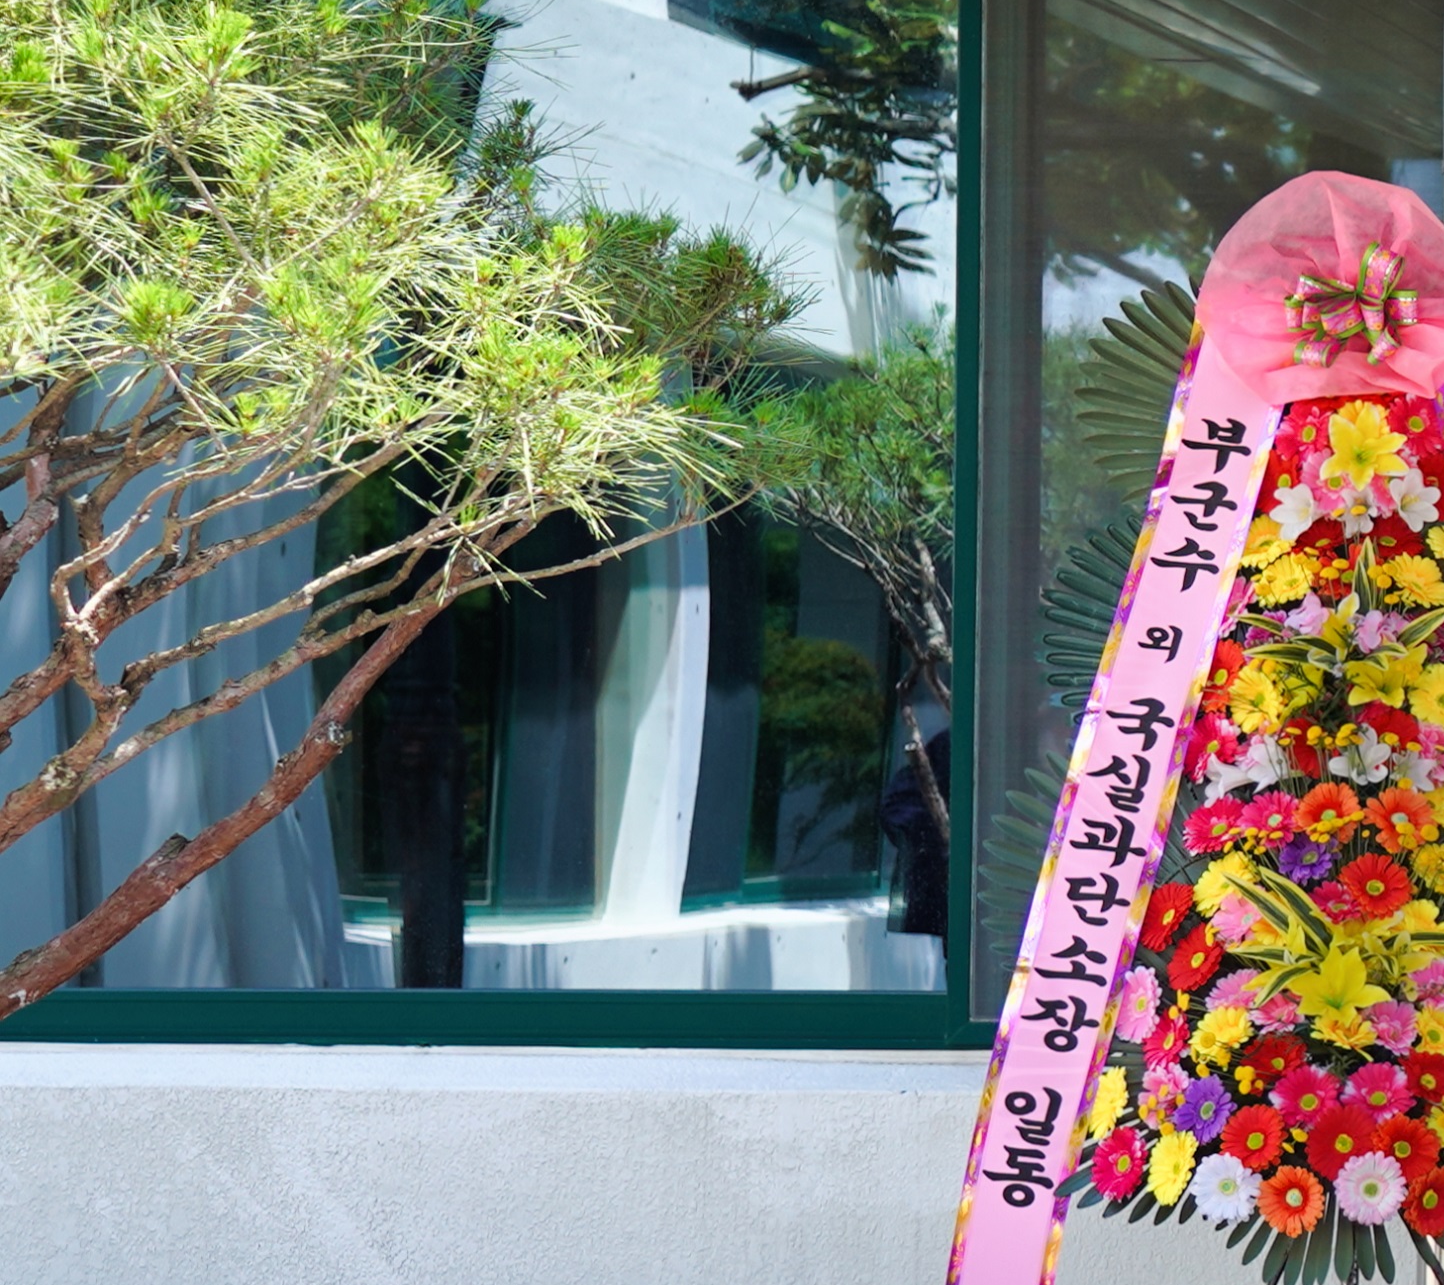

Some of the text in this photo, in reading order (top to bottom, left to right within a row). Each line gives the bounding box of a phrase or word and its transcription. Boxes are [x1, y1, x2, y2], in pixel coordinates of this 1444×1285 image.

[982, 418, 1252, 1208] 부군수 외 국실과단소장 일동
